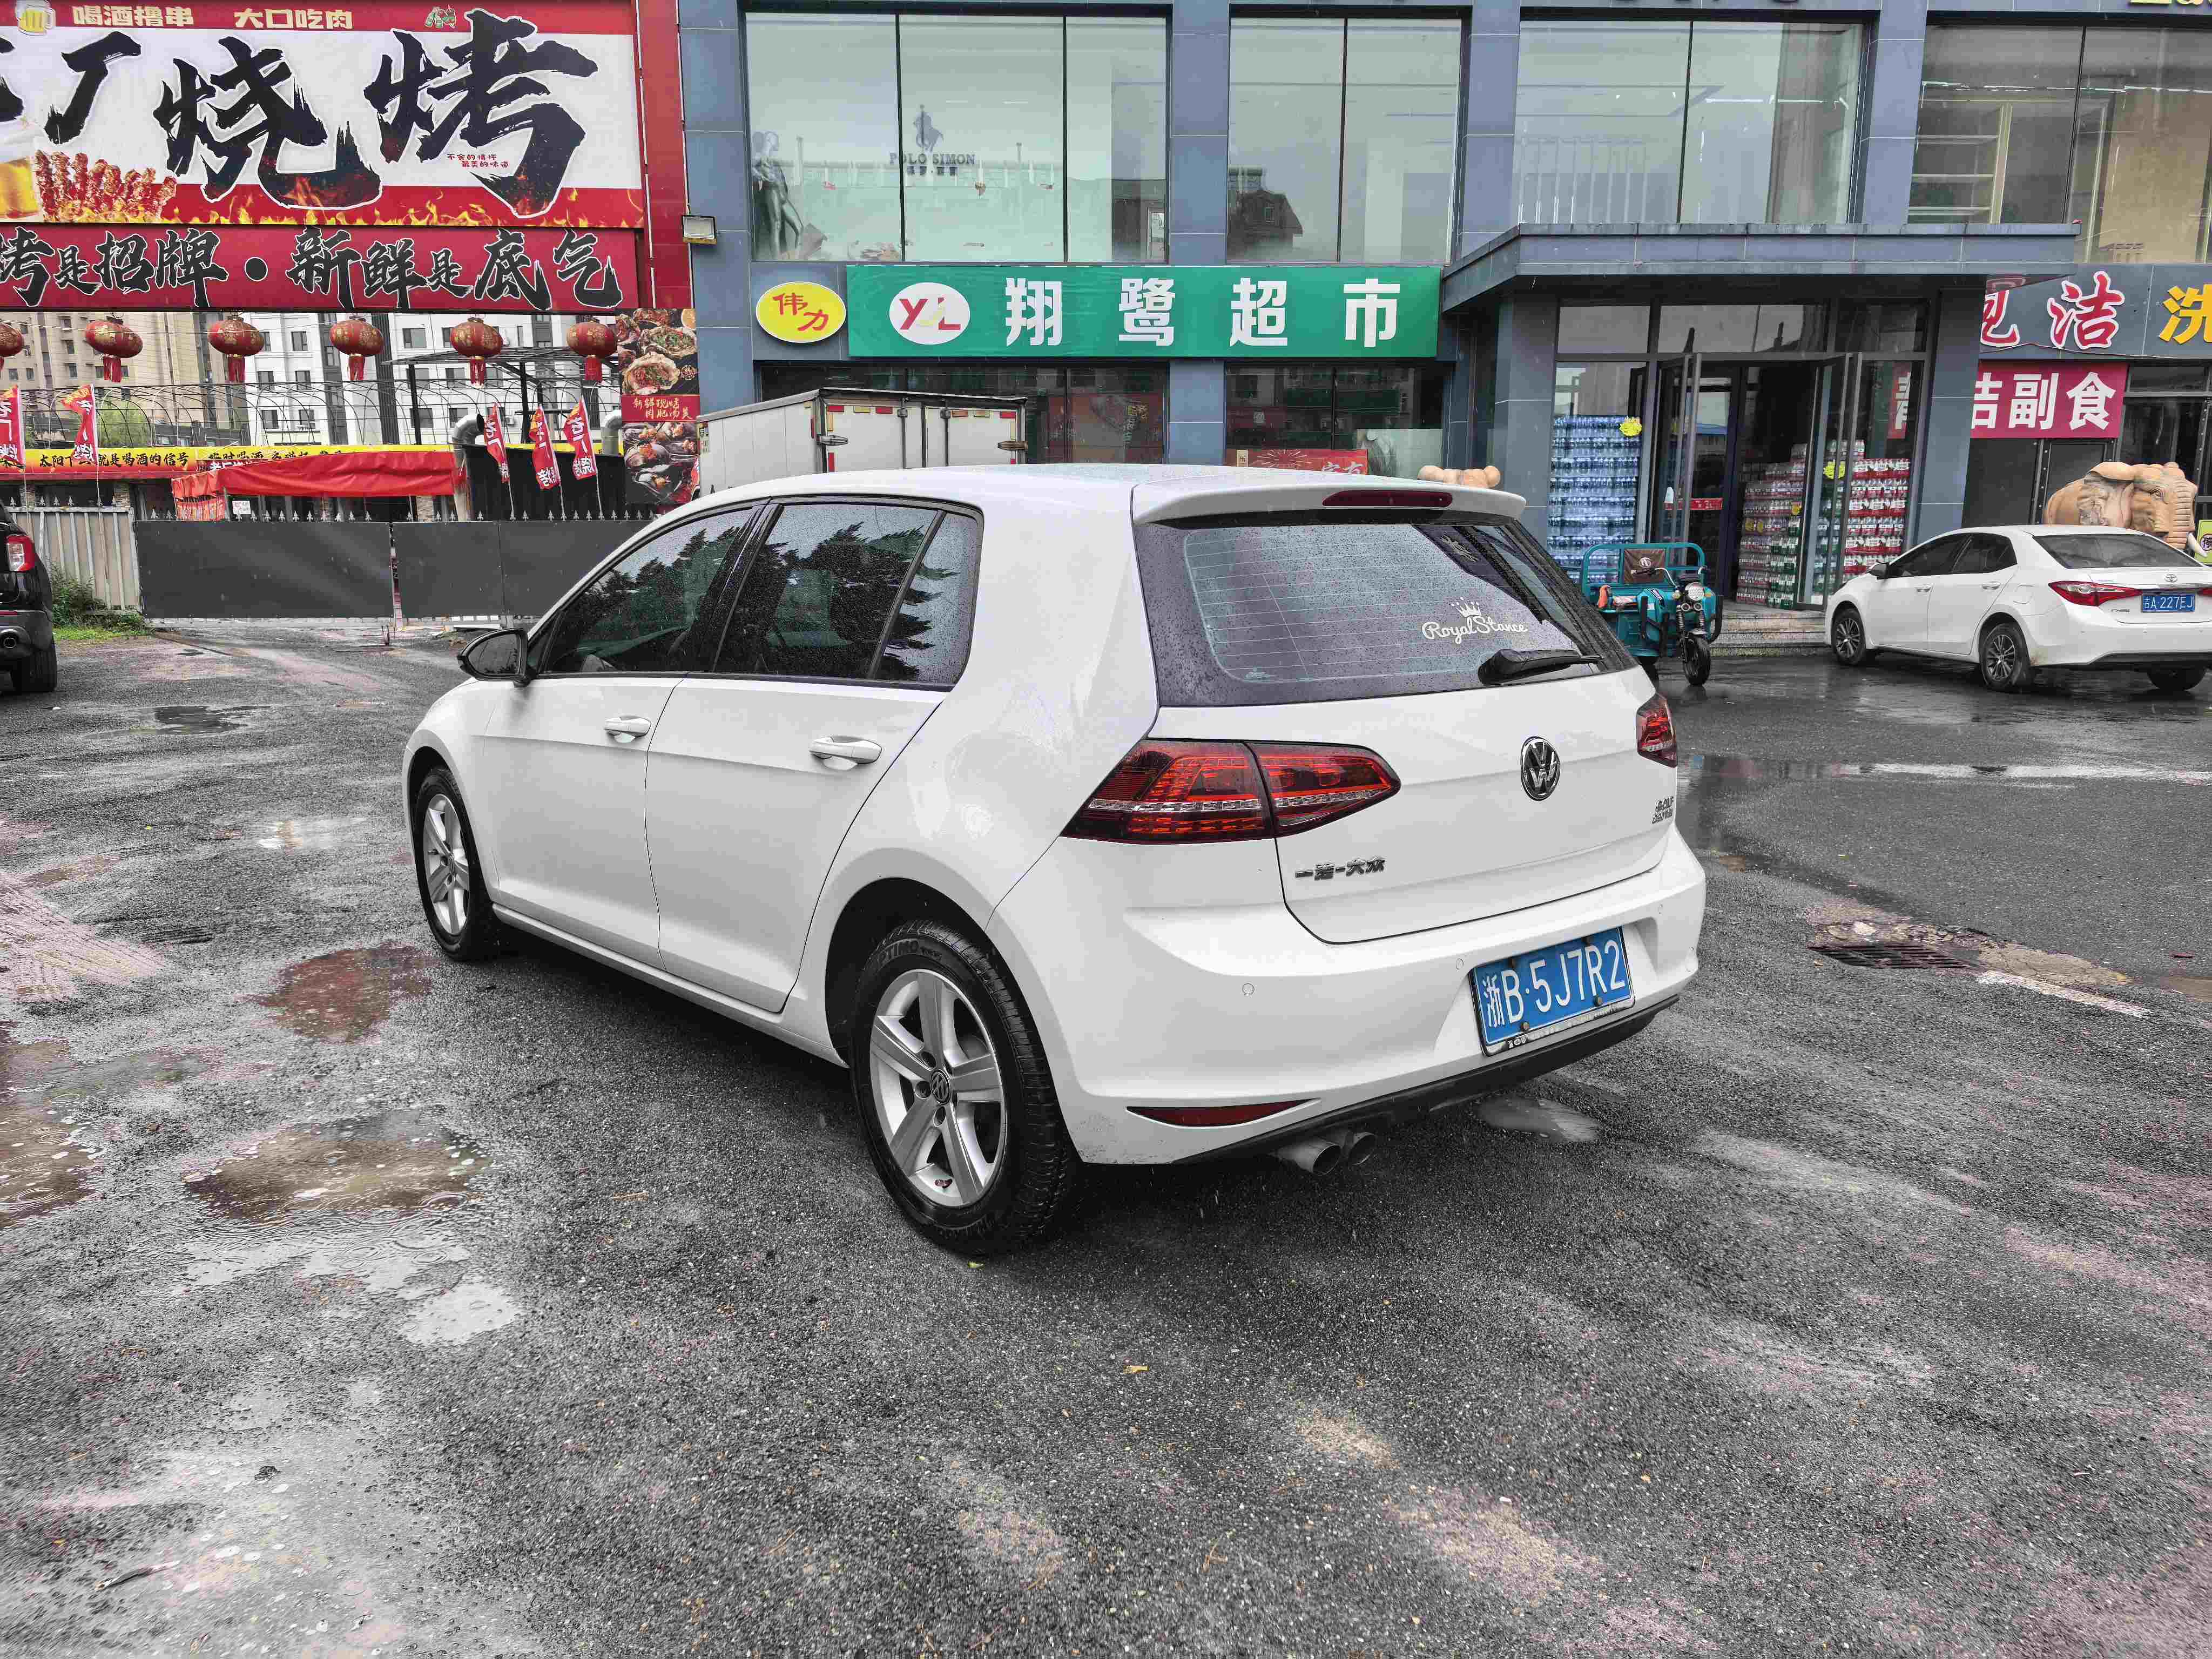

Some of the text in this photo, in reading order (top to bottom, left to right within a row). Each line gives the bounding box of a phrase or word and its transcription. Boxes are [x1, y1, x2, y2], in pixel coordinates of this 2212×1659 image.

[72, 6, 354, 29] 喝酒撸串 大口吃肉
[0, 10, 598, 218] 厂烧烤
[933, 153, 976, 165] SIMON
[1004, 277, 1400, 347] 翔鹭超市
